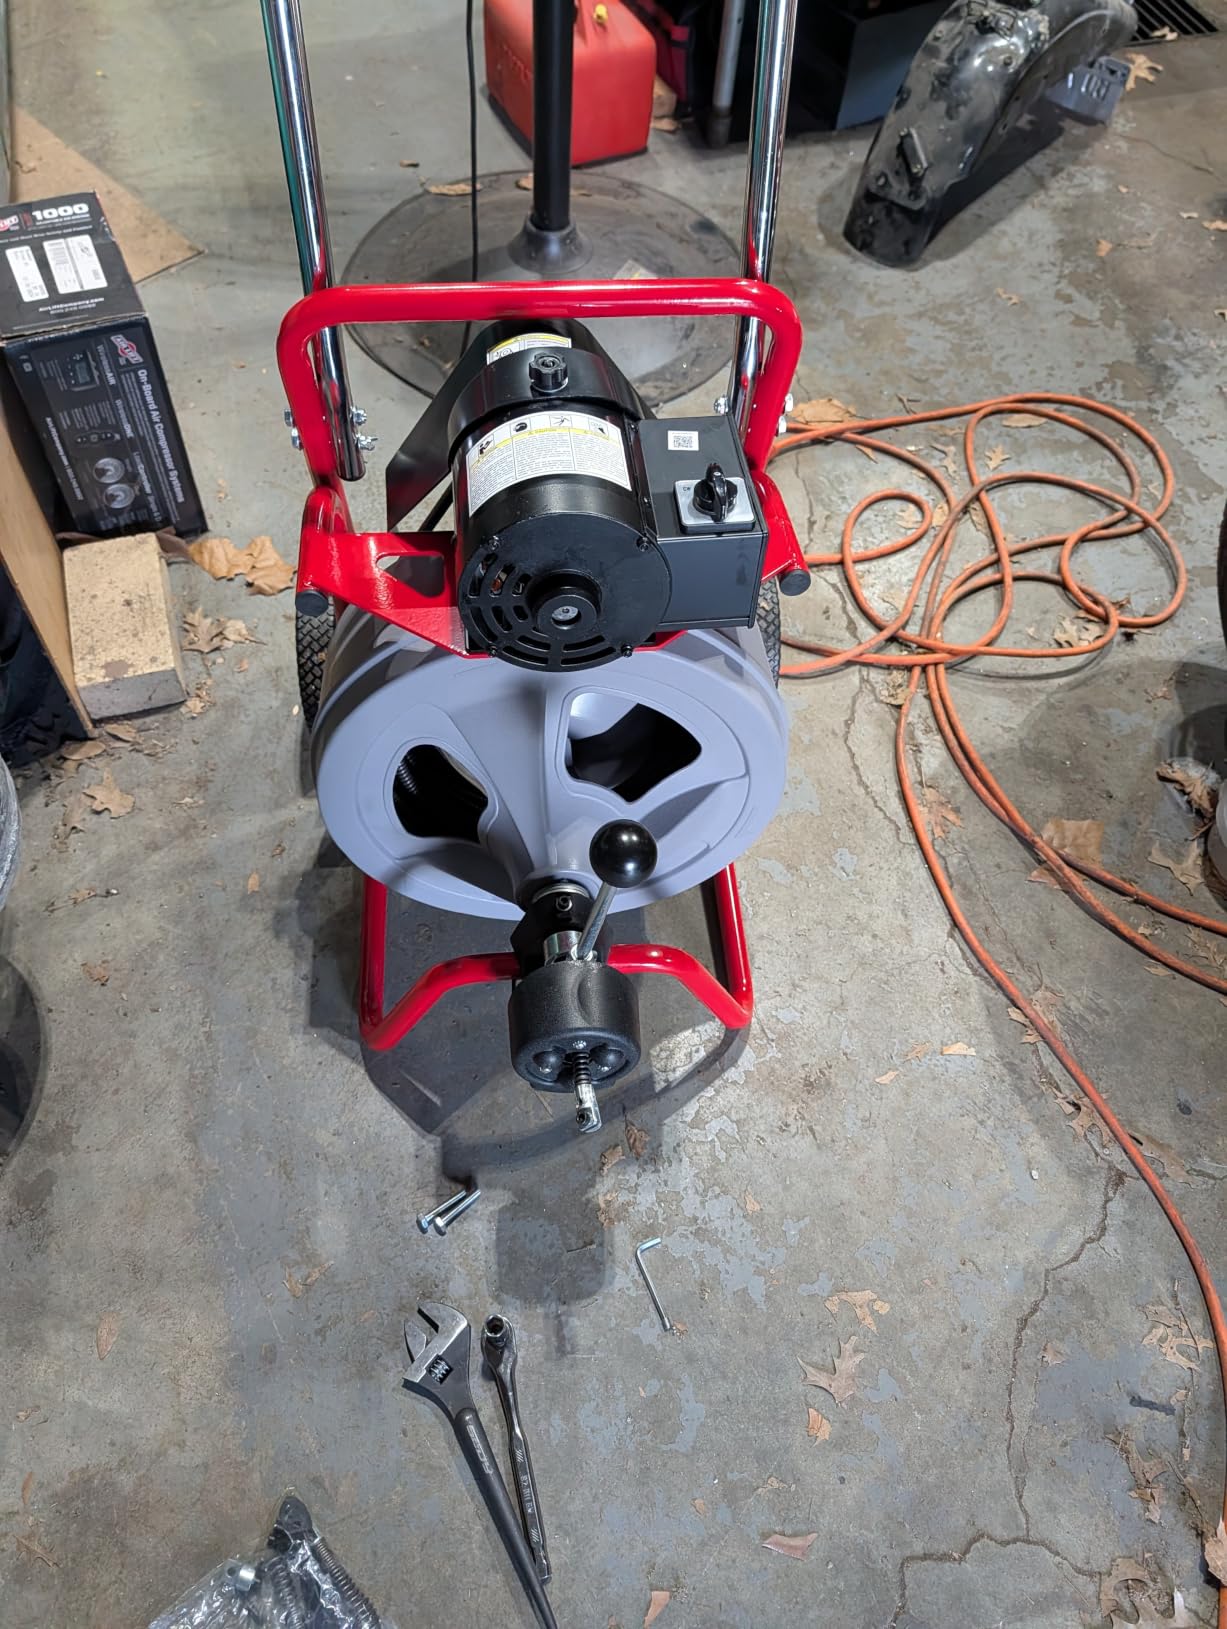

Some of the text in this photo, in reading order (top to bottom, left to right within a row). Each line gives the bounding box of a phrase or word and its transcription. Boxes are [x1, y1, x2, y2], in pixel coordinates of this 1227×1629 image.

[31, 203, 89, 220] 1000
[137, 369, 158, 410] On-Board
[150, 410, 161, 423] Air
[154, 423, 175, 470] Compressor
[168, 470, 184, 503] Systems
